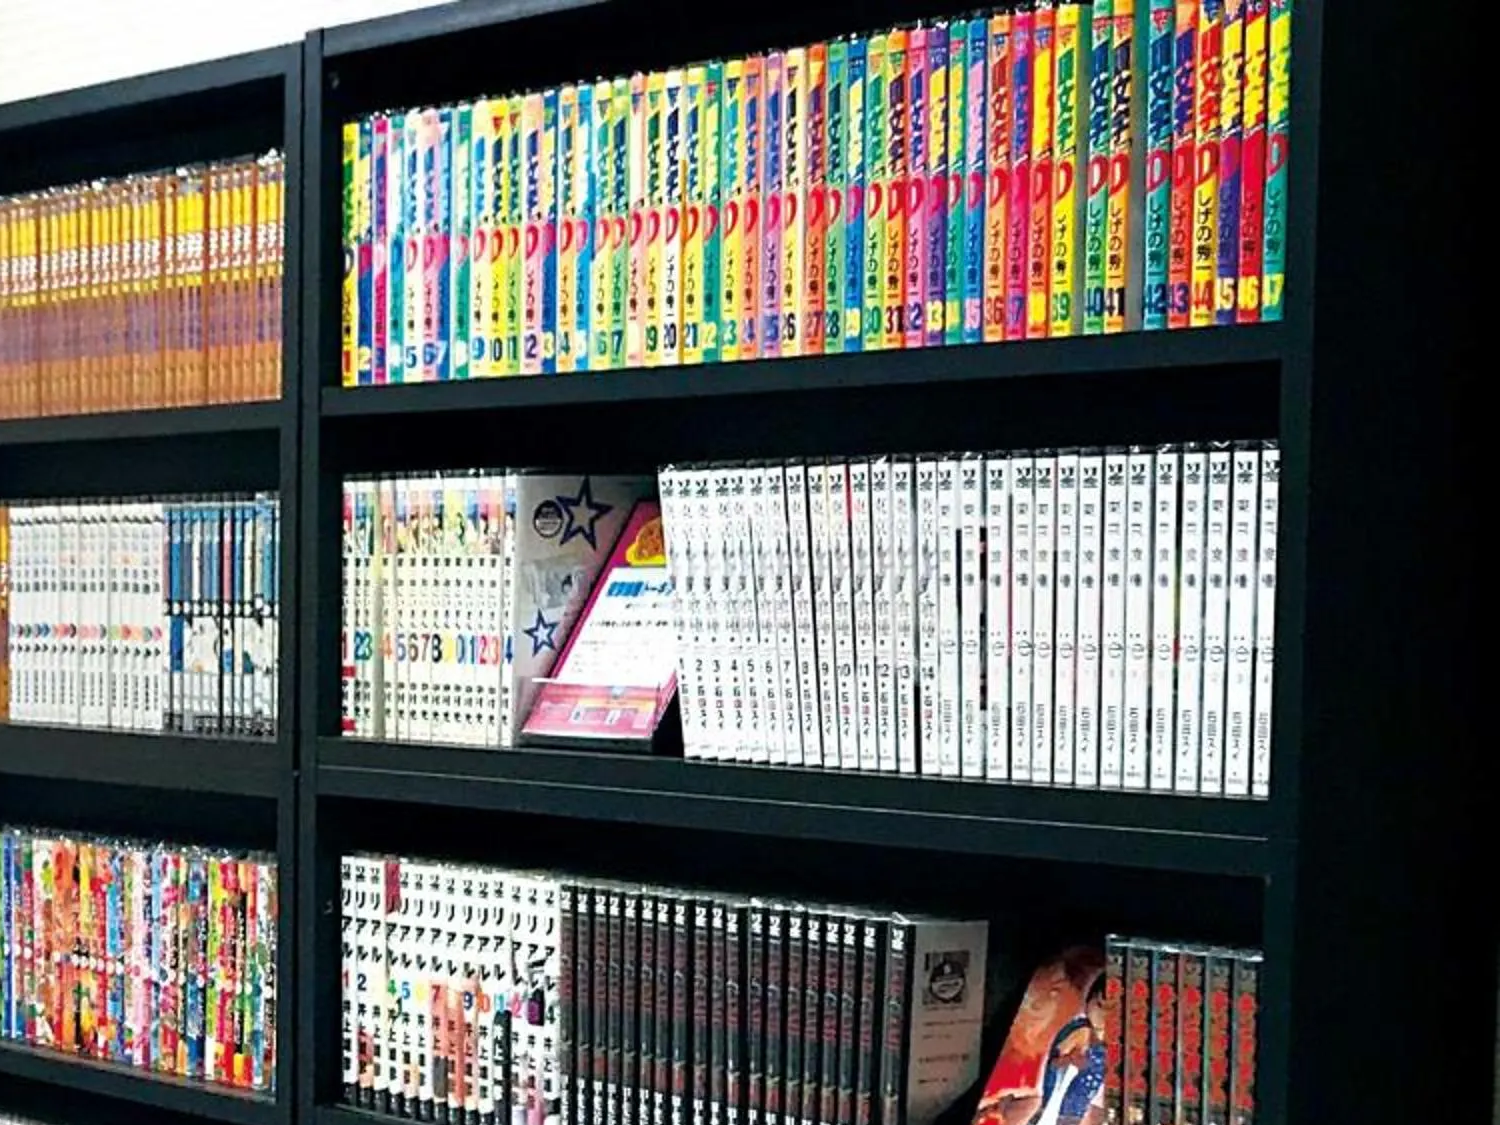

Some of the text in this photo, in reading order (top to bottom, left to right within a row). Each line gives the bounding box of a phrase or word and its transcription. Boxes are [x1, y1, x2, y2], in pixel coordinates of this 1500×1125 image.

[396, 634, 406, 661] 5
[408, 633, 419, 662] 6
[421, 634, 430, 661] 7
[431, 633, 442, 663] 8
[357, 973, 367, 991] 2
[402, 981, 411, 999] 5
[432, 985, 441, 1001] 7
[463, 992, 473, 1010] 9
